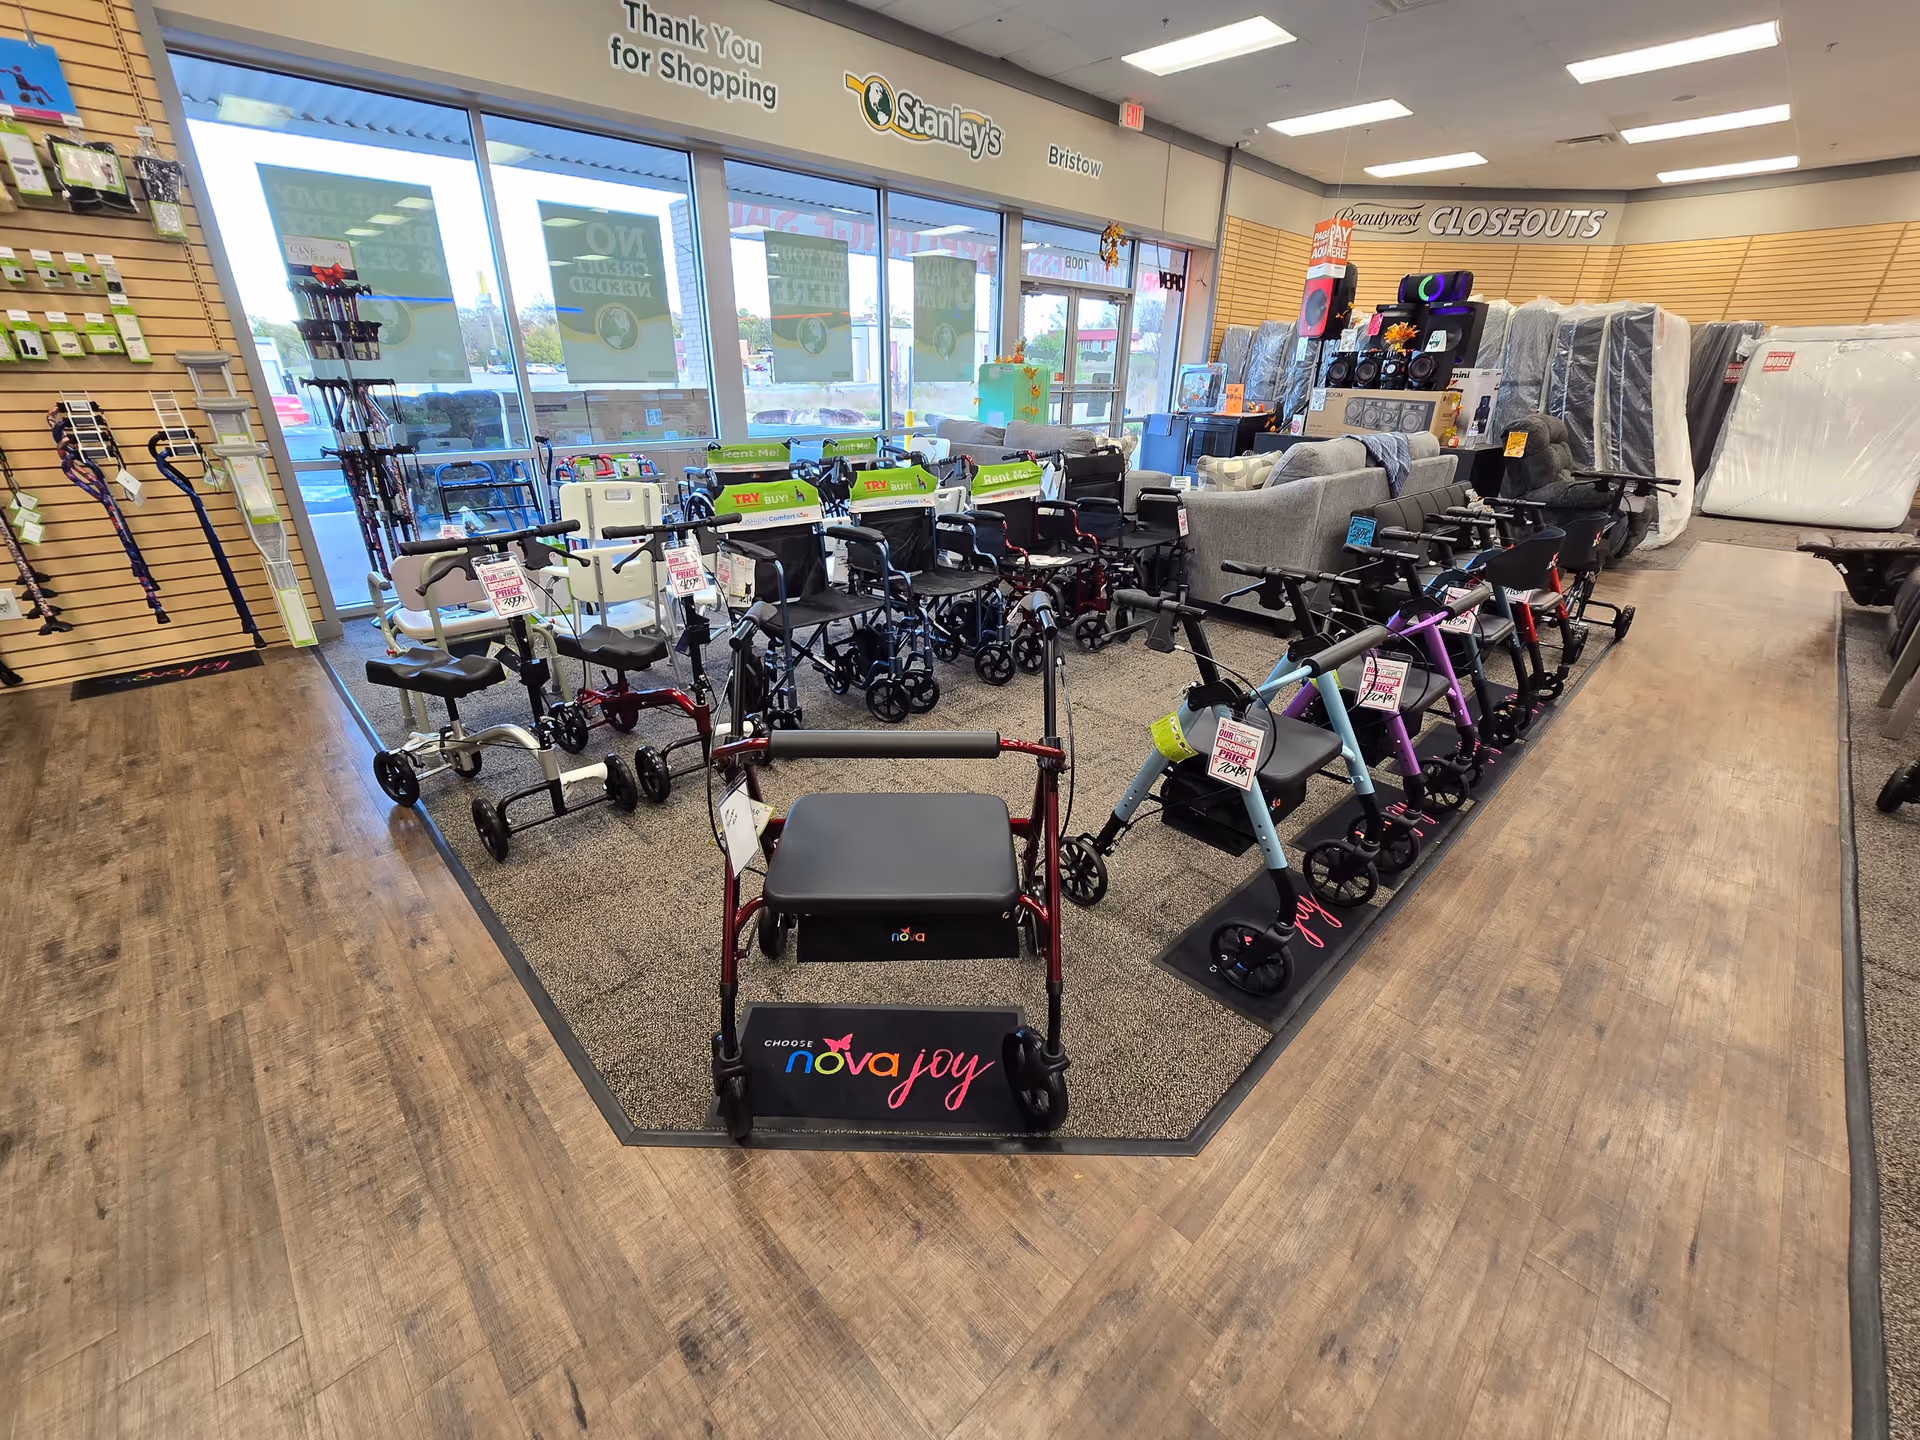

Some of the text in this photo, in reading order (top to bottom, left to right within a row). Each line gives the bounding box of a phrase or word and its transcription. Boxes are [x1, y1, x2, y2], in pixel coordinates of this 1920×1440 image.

[623, 1, 760, 65] Thank You
[611, 36, 777, 109] for Shopping
[1125, 102, 1143, 129] EXIT
[898, 93, 1002, 160] Stanley's
[1048, 144, 1102, 178] Bristow
[1427, 206, 1608, 239] CLOSEOUTS
[1330, 224, 1352, 242] PAY
[1765, 356, 1792, 367] MODEL
[722, 448, 780, 458] Rent Me!
[856, 442, 871, 450] Me!
[983, 468, 1033, 485] Rent Me!
[864, 481, 913, 491] TRY BUY!
[732, 492, 761, 504] TRY
[764, 494, 790, 505] BUY!
[768, 513, 796, 522] Comfort
[482, 573, 498, 583] OUR
[488, 578, 521, 590] DISCOUNT
[495, 586, 523, 598] PRICE
[1218, 728, 1235, 741] OUR
[1218, 739, 1255, 758] DISCOUNT
[1218, 749, 1250, 766] PRICE
[891, 927, 926, 943] nova
[764, 1039, 813, 1048] CHOOSE
[785, 1047, 996, 1111] nova joy
